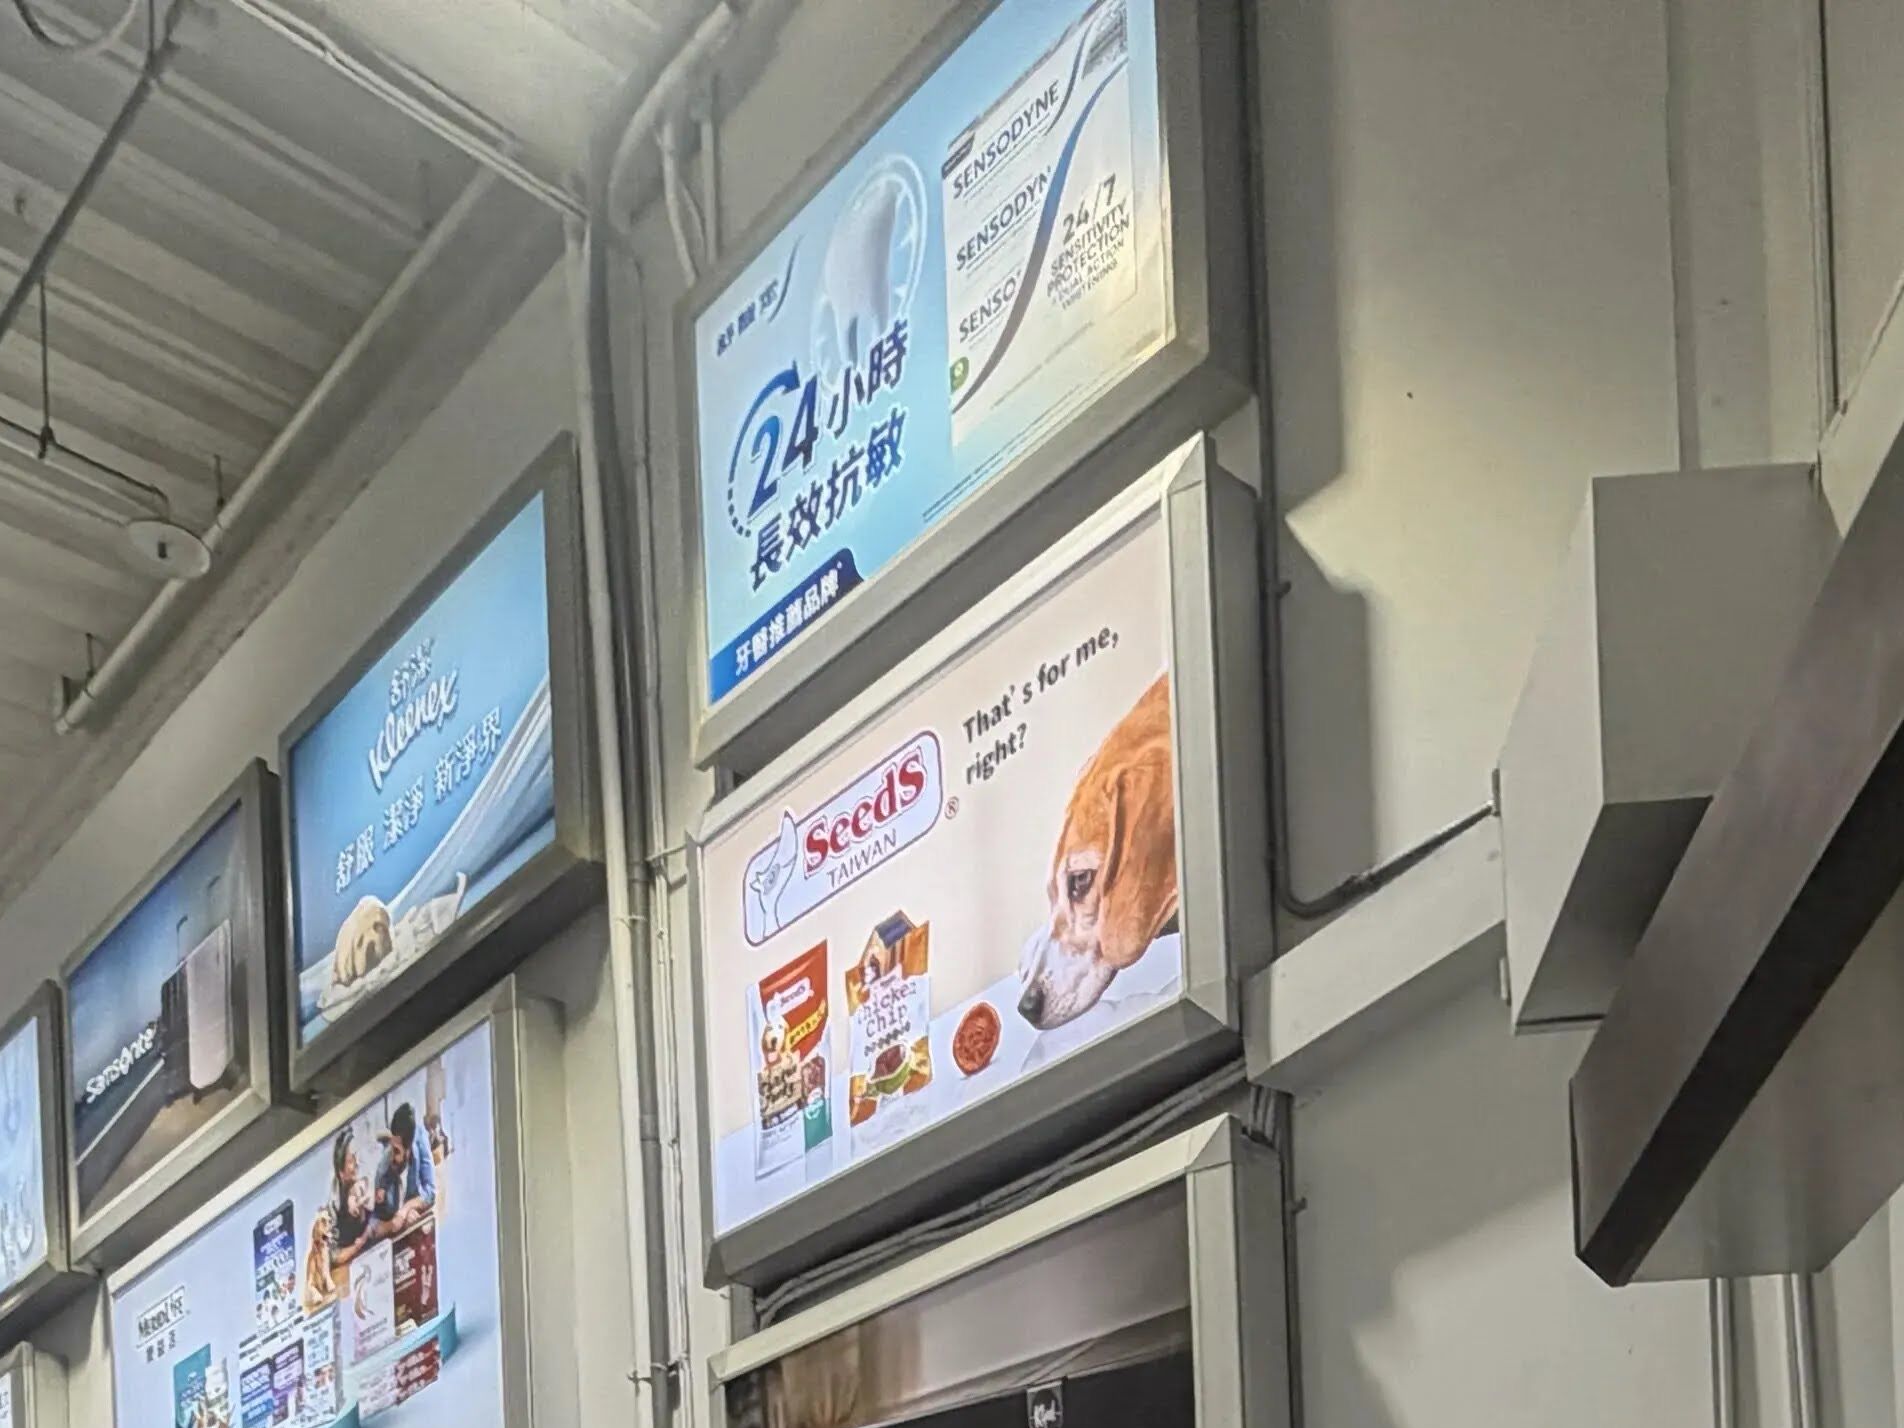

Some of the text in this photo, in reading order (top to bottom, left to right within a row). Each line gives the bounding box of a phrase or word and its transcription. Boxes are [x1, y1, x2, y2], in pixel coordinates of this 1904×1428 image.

[953, 80, 1059, 199] SENSODYNE
[1051, 198, 1127, 276] SENSITIVITY
[1062, 173, 1116, 245] 24/7
[1047, 214, 1130, 297] PROTECTION
[750, 407, 907, 592] 長效抗敏
[1037, 653, 1070, 693] for
[1075, 628, 1120, 667] me,
[369, 670, 457, 791] Kleenex
[966, 723, 1027, 785] right?
[827, 829, 897, 889] TAIWAN
